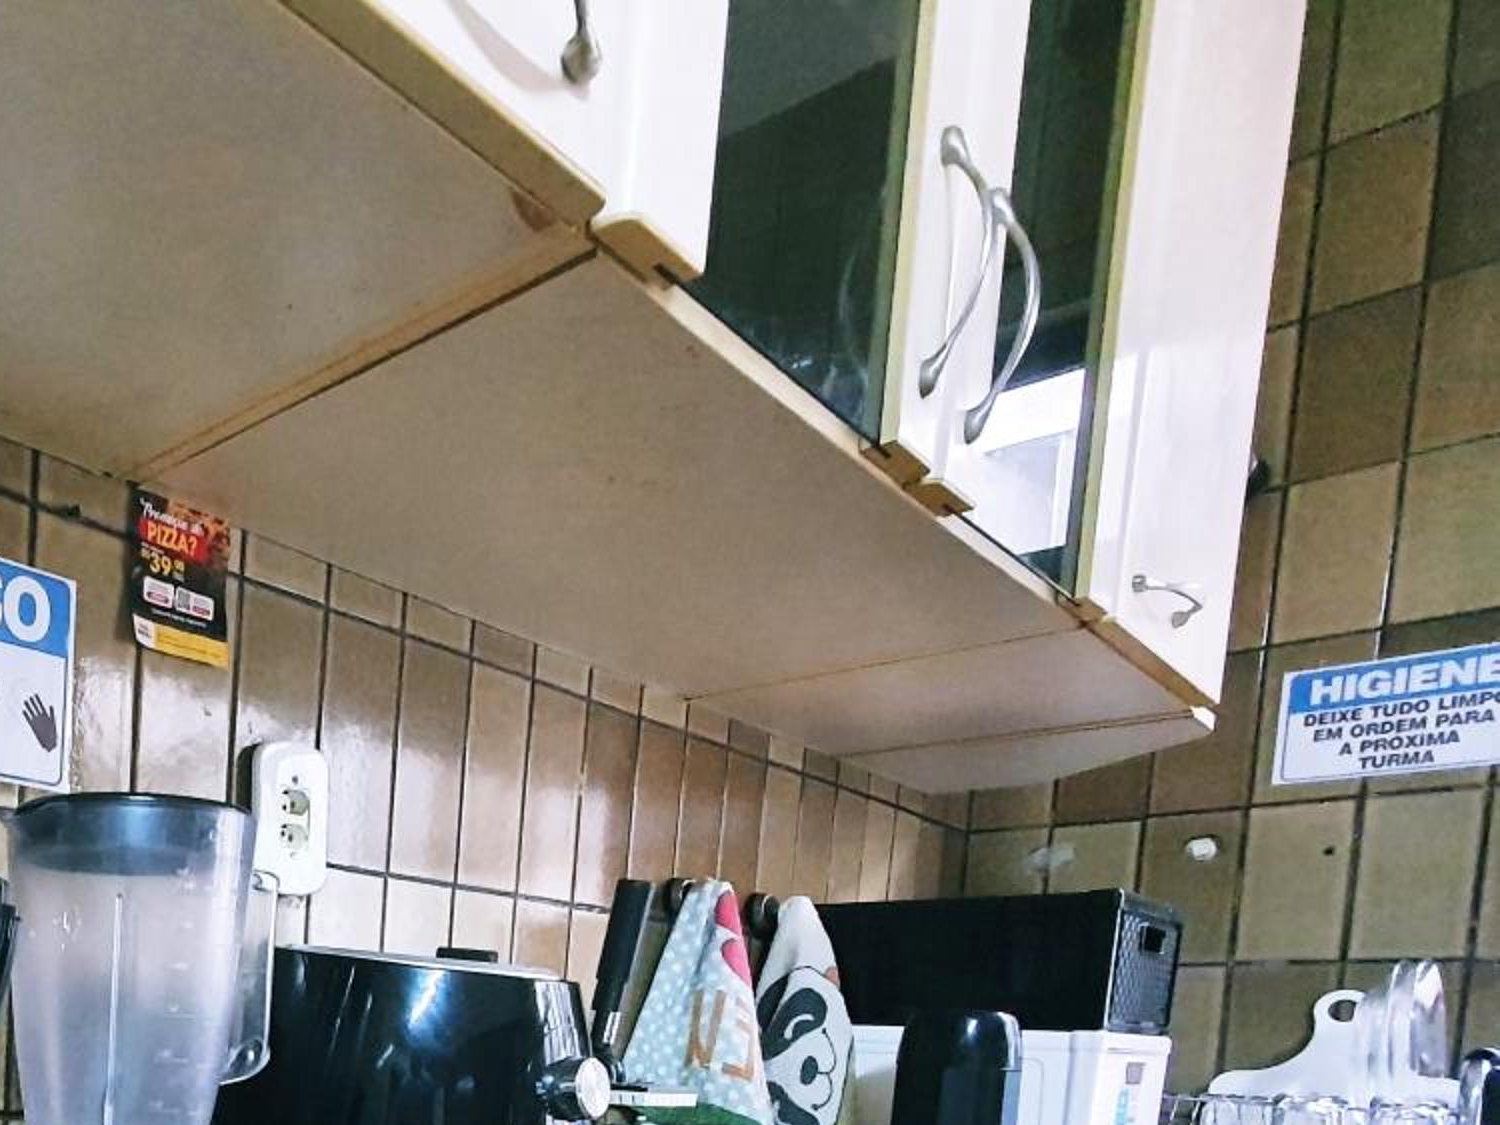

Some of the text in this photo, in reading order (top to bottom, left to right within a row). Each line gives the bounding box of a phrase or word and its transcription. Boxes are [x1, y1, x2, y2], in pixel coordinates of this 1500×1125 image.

[147, 520, 199, 557] PIZZA?
[1310, 652, 1500, 705] HIGIENE
[1304, 708, 1363, 727] DEIXE
[1371, 699, 1430, 717] TUDO
[1313, 709, 1495, 742] EM ORDEM PARA
[1338, 744, 1352, 756] A
[1359, 750, 1435, 769] TURMA
